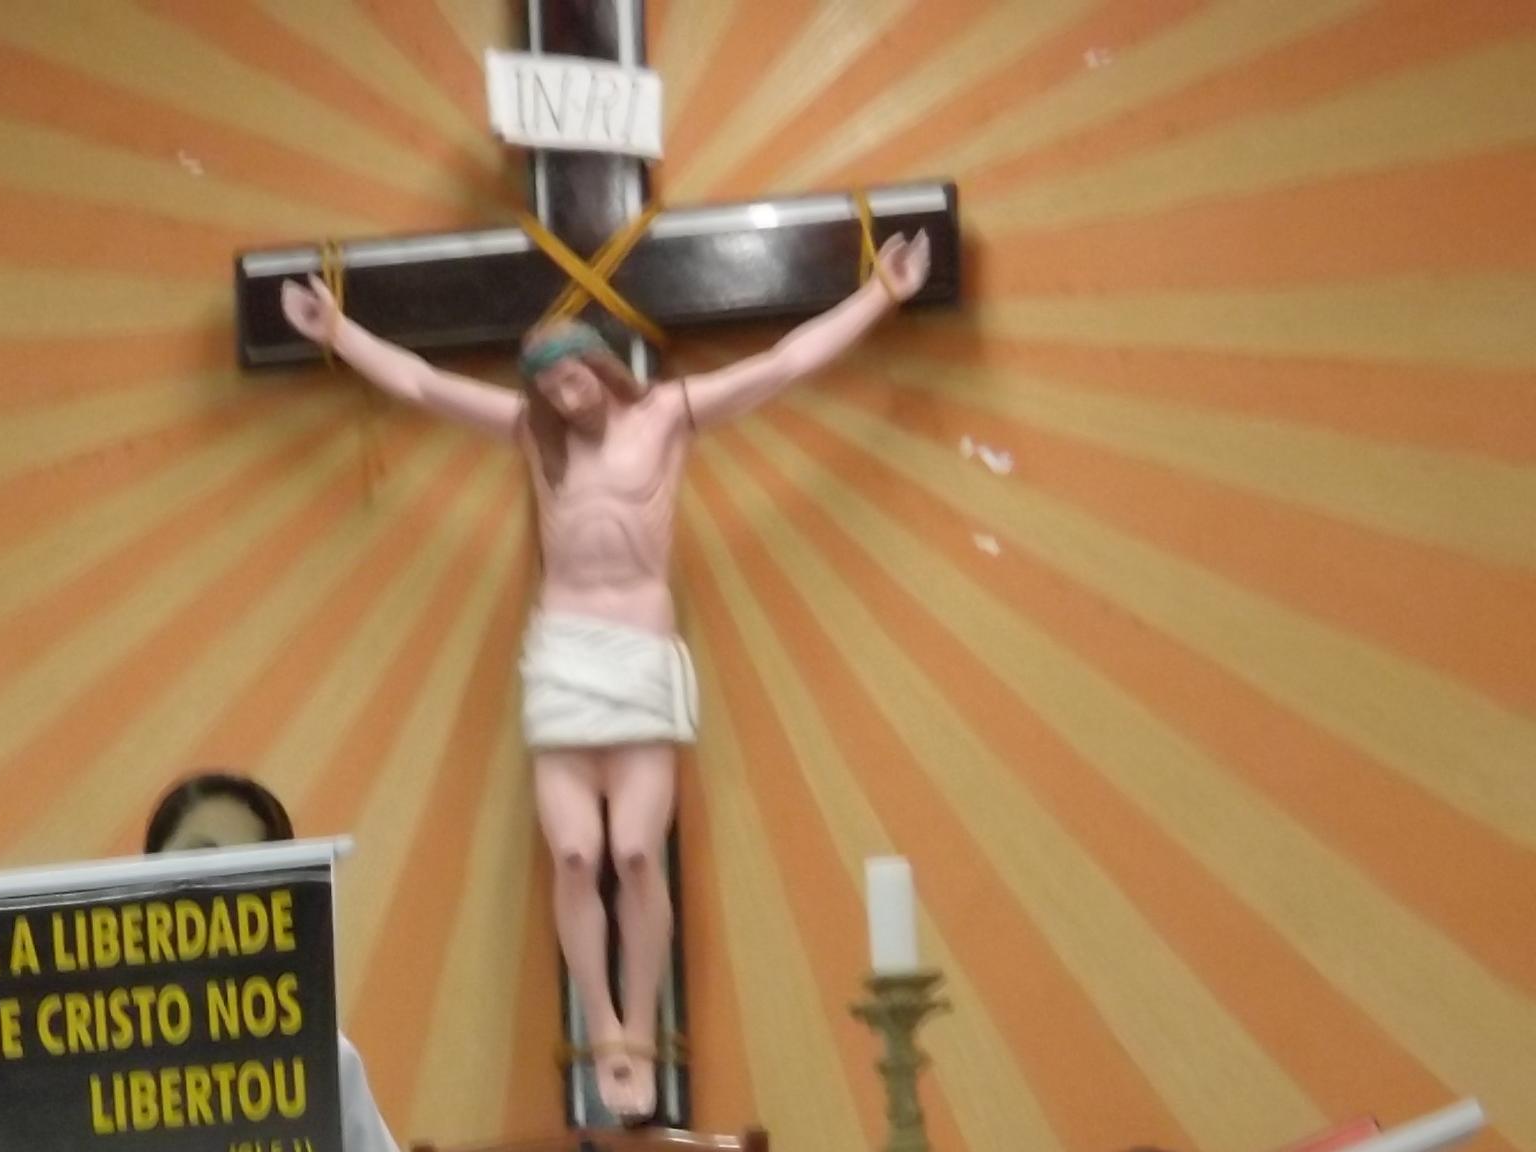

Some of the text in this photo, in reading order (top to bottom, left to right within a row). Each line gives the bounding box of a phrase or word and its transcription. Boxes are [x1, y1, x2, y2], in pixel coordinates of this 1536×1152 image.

[515, 67, 639, 143] INRI
[10, 914, 42, 976] A
[52, 889, 297, 973] LIBERDADE
[37, 983, 192, 1056] CRISTO
[206, 972, 304, 1042] NOS
[89, 1056, 308, 1135] LIBERTOU
